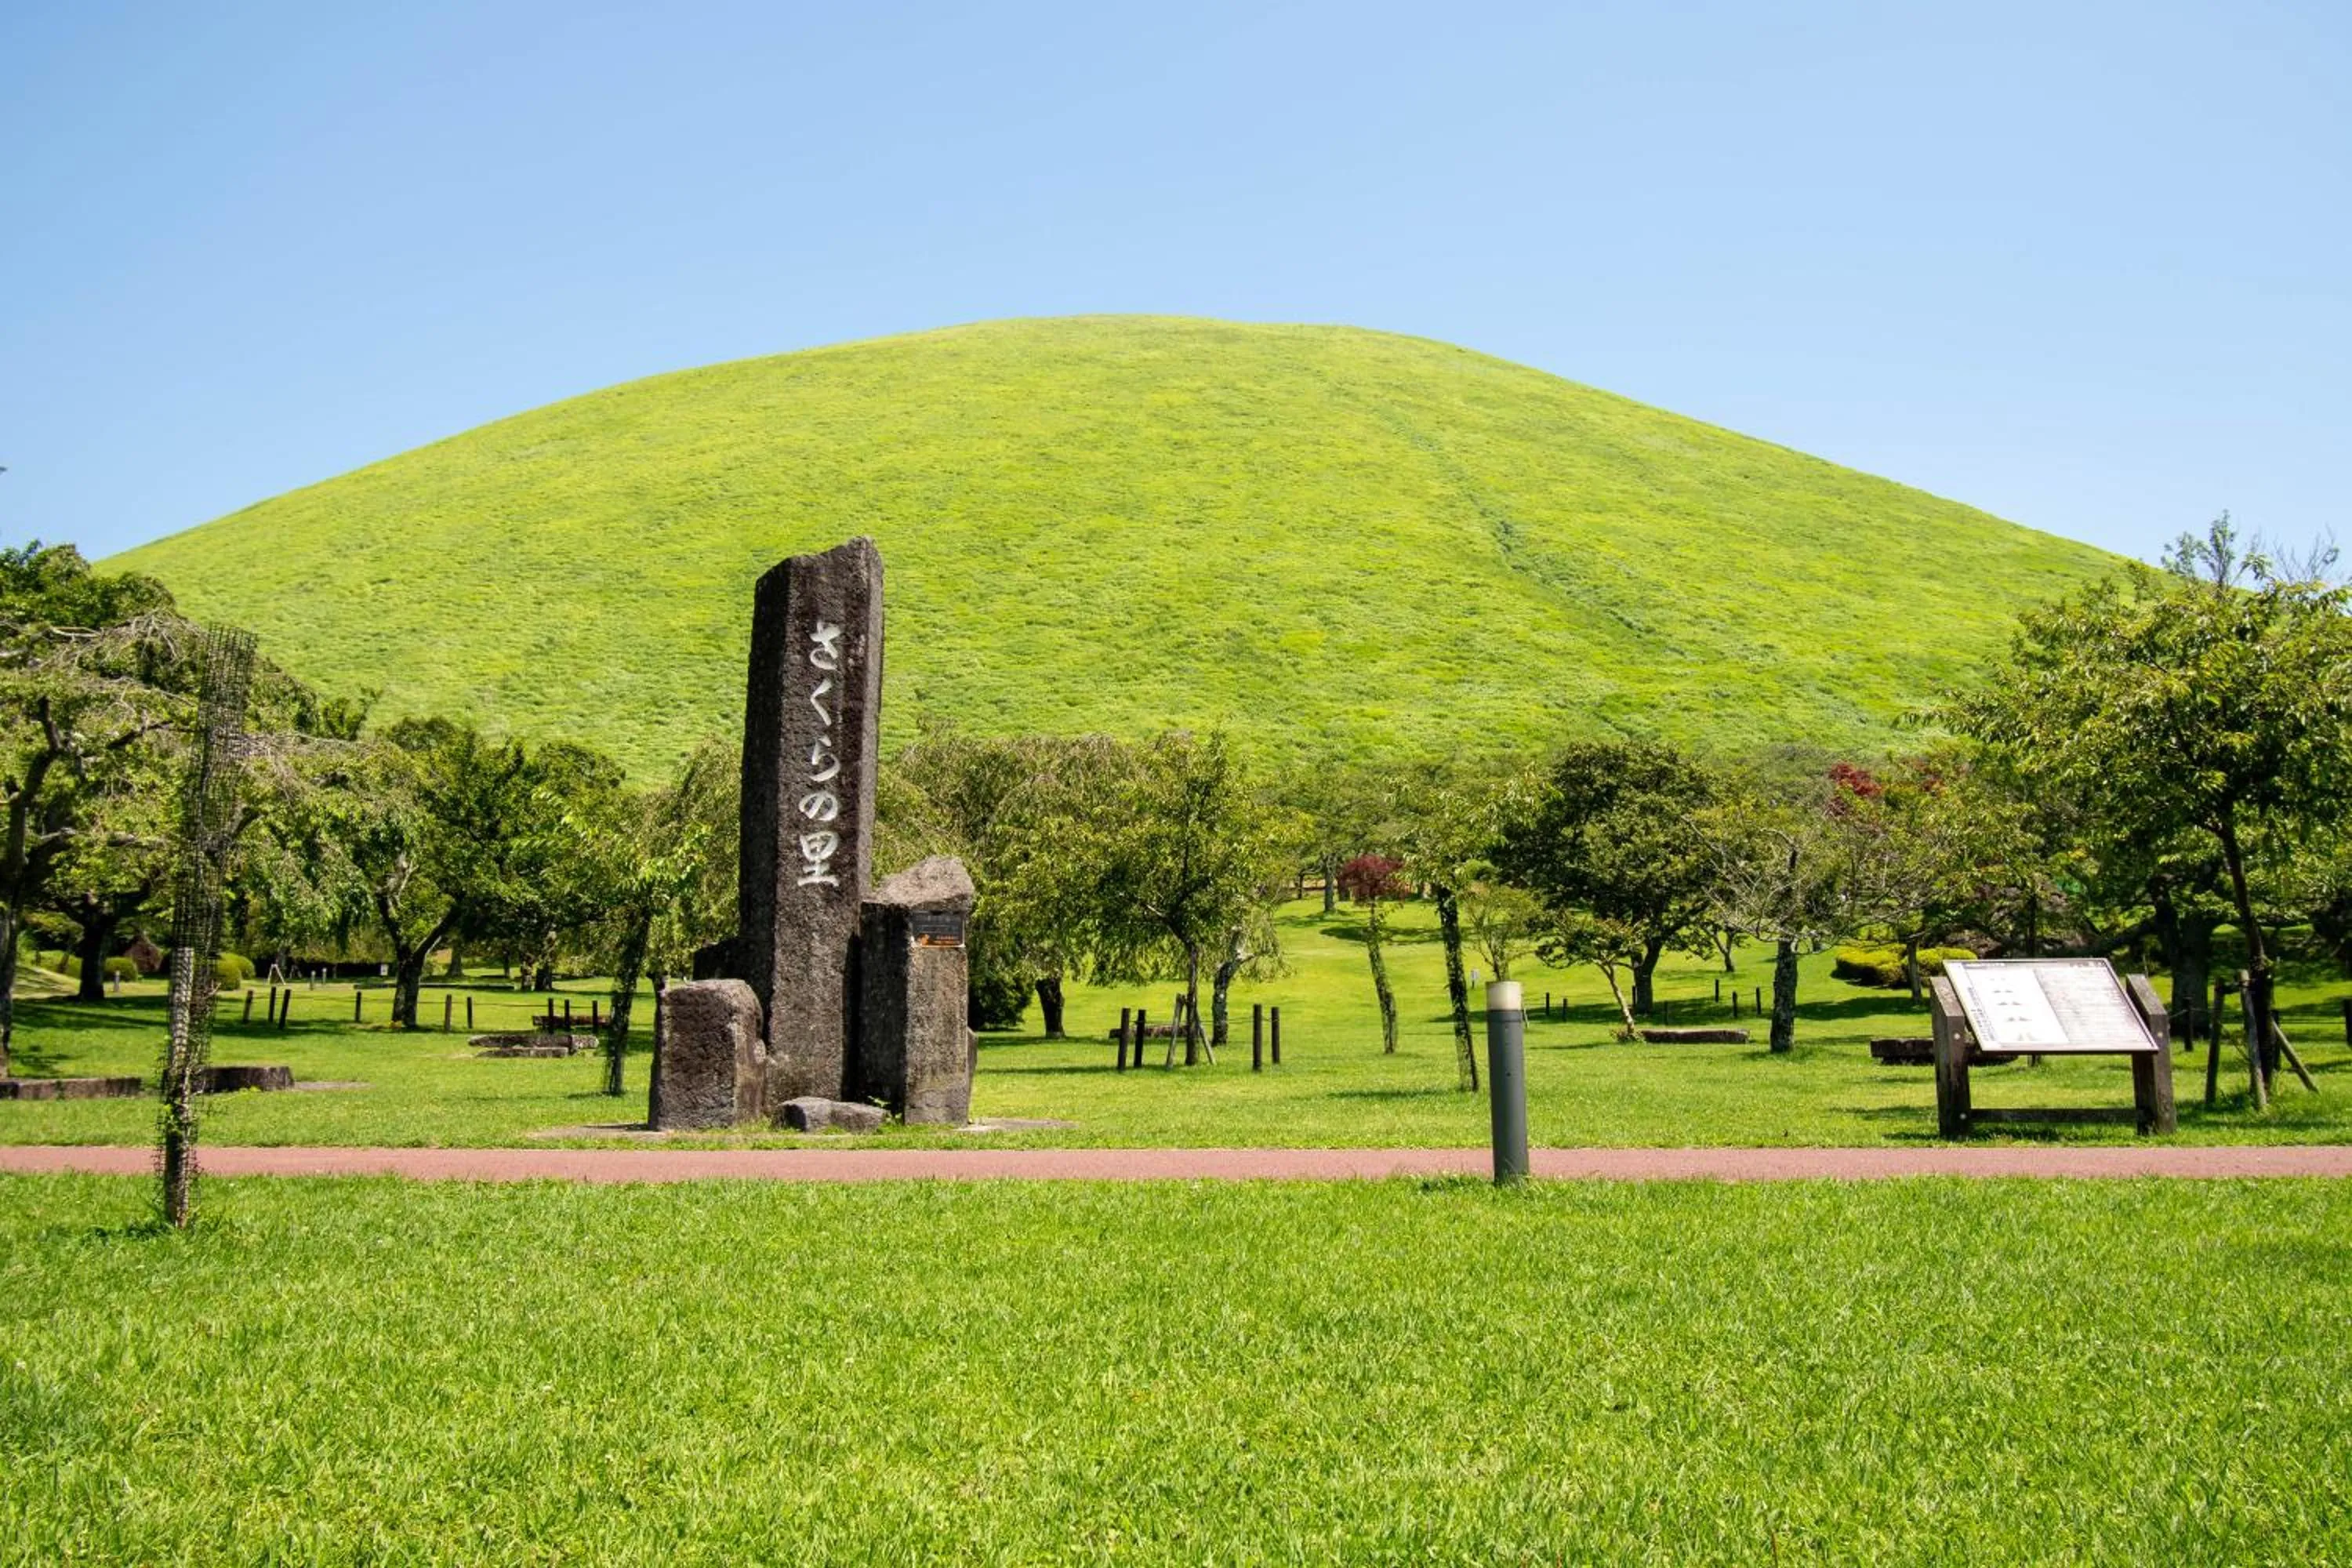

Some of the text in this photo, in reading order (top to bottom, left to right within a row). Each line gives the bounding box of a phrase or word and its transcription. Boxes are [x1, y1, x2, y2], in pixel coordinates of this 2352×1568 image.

[797, 619, 841, 887] さくらの里
